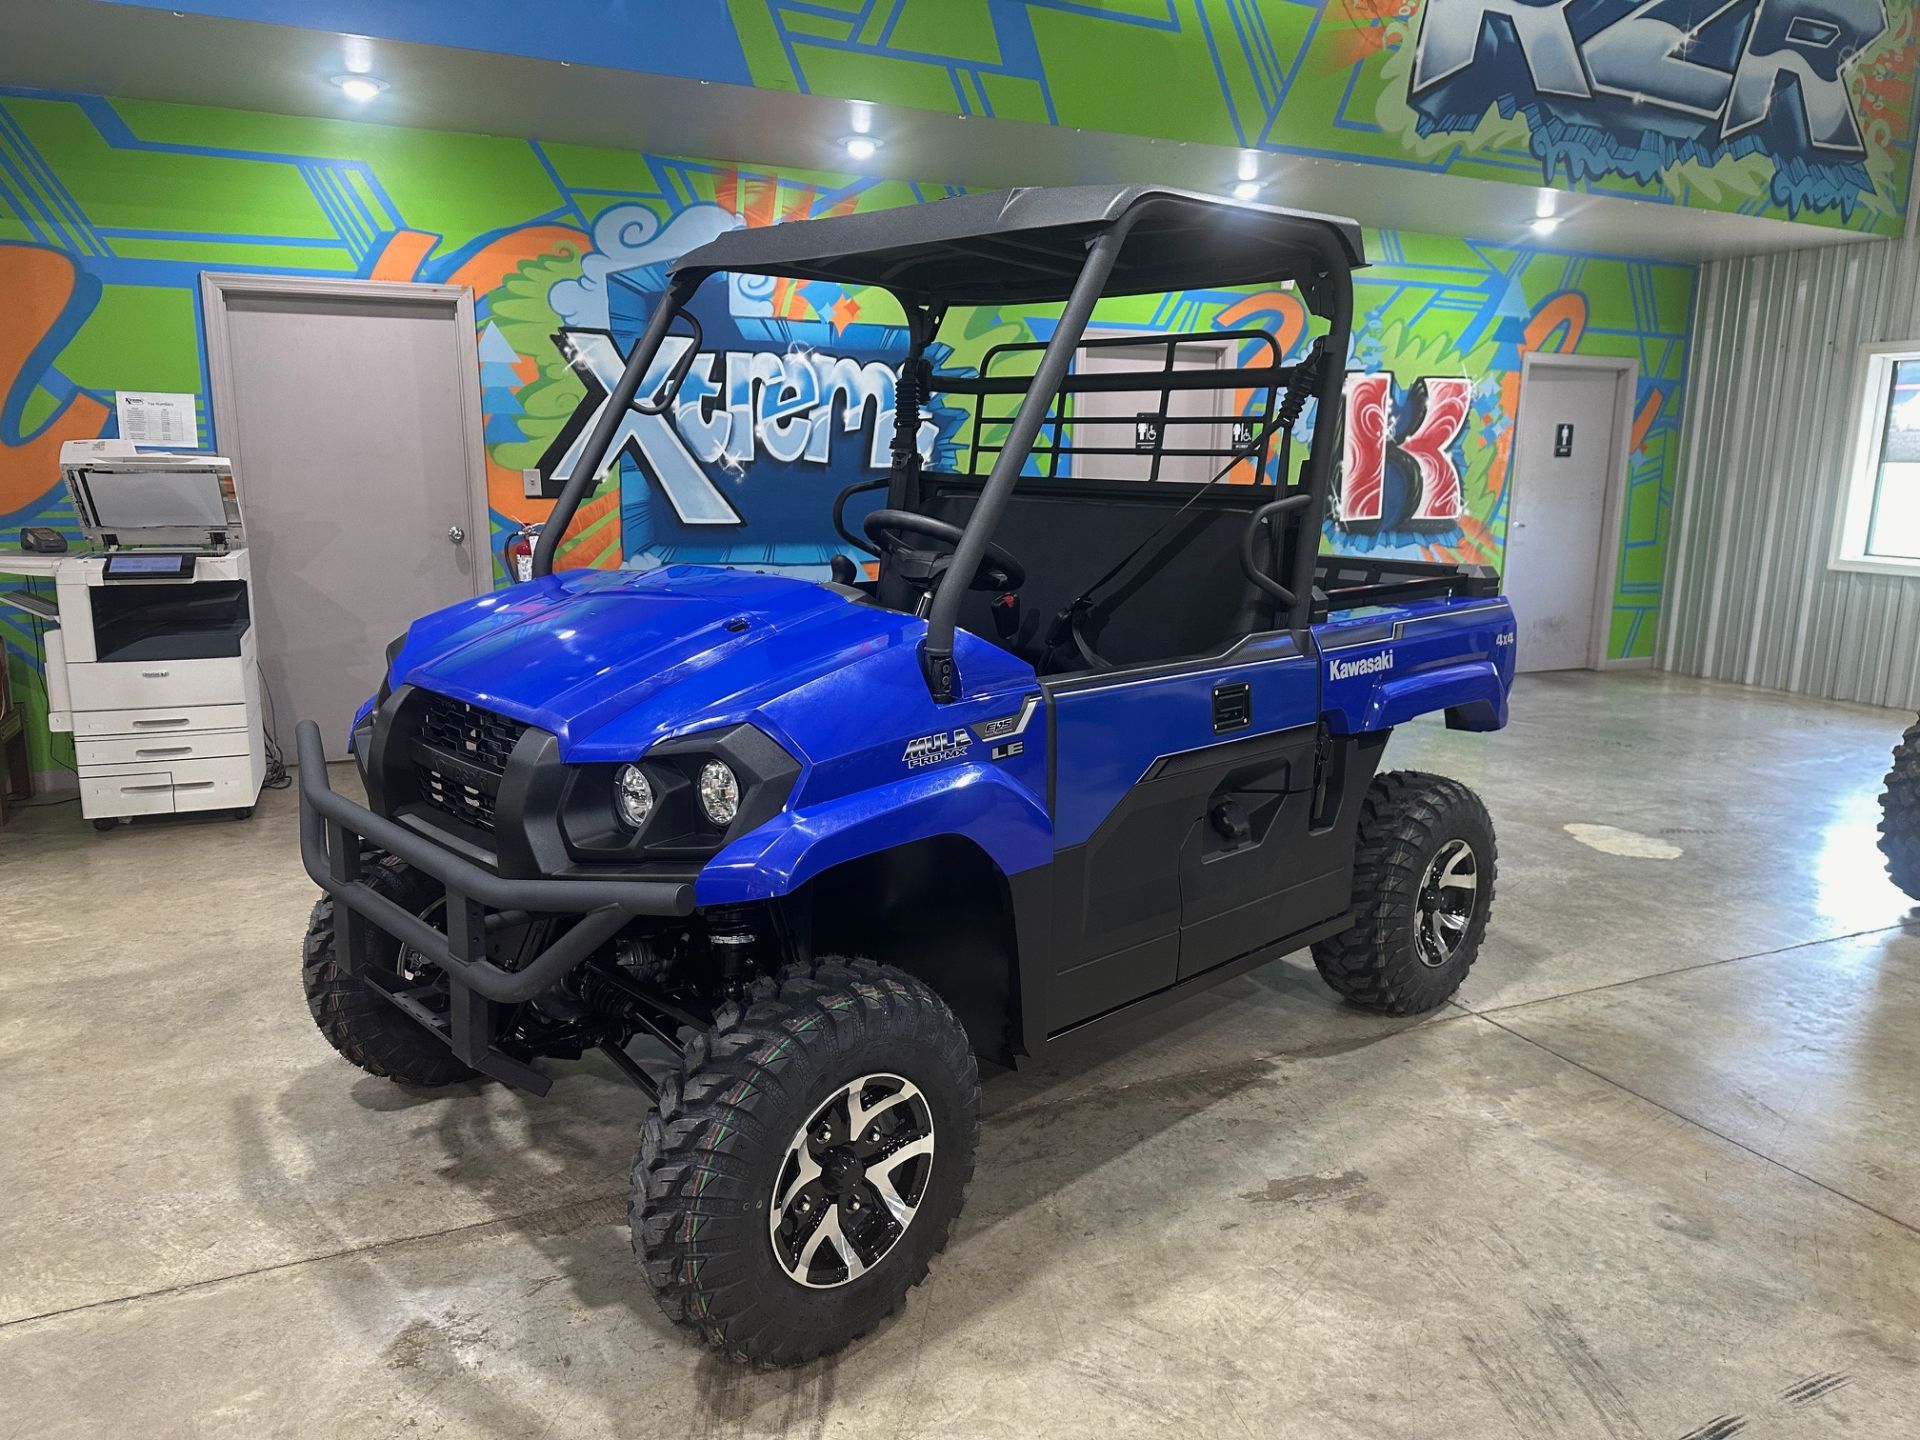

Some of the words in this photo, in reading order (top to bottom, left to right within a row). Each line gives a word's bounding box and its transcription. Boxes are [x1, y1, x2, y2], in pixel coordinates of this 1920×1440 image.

[1495, 631, 1514, 646] 4x4
[1330, 649, 1394, 681] Kawasaki
[992, 742, 1023, 760] LE
